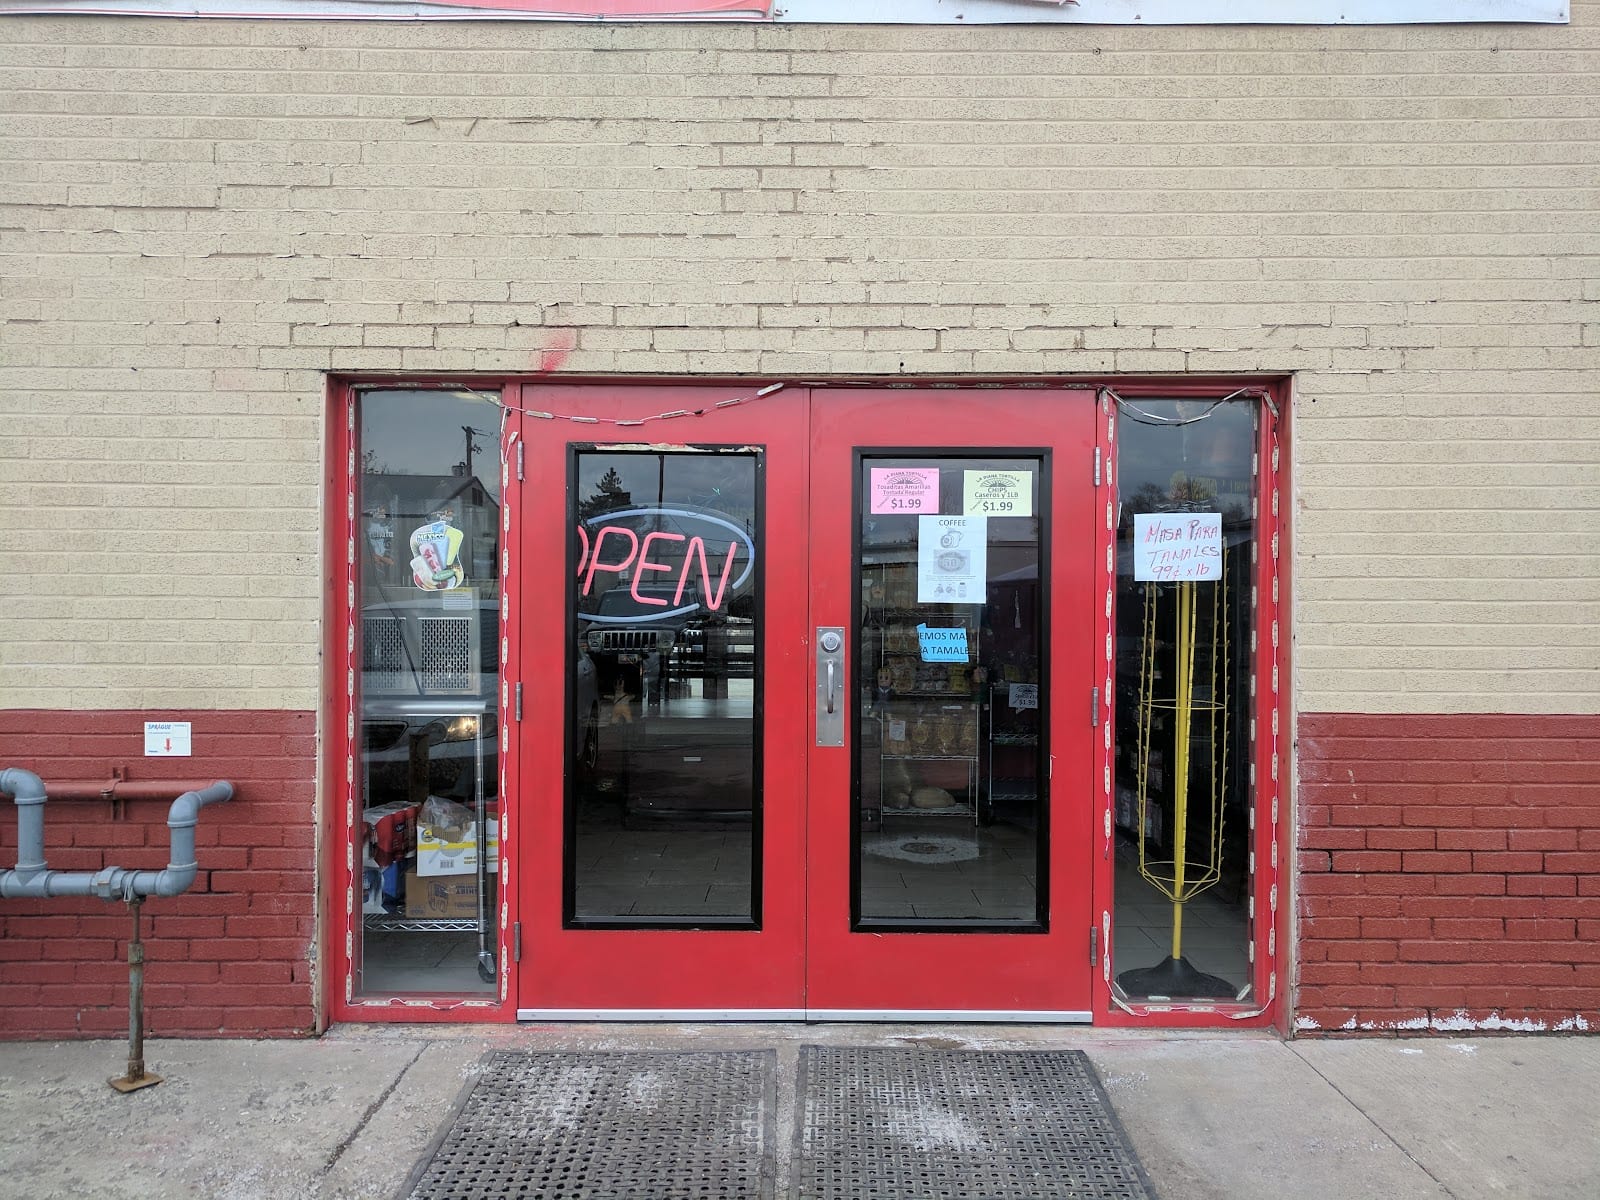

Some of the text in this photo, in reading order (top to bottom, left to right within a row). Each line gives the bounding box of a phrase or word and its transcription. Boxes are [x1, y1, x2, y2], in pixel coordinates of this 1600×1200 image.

[891, 497, 921, 510] $1.99
[982, 501, 1013, 512] $1.99
[938, 519, 967, 527] COFFEE
[1144, 519, 1218, 546] MASA PARA
[1147, 545, 1220, 568] TAMALES
[919, 632, 967, 641] EMOS MA
